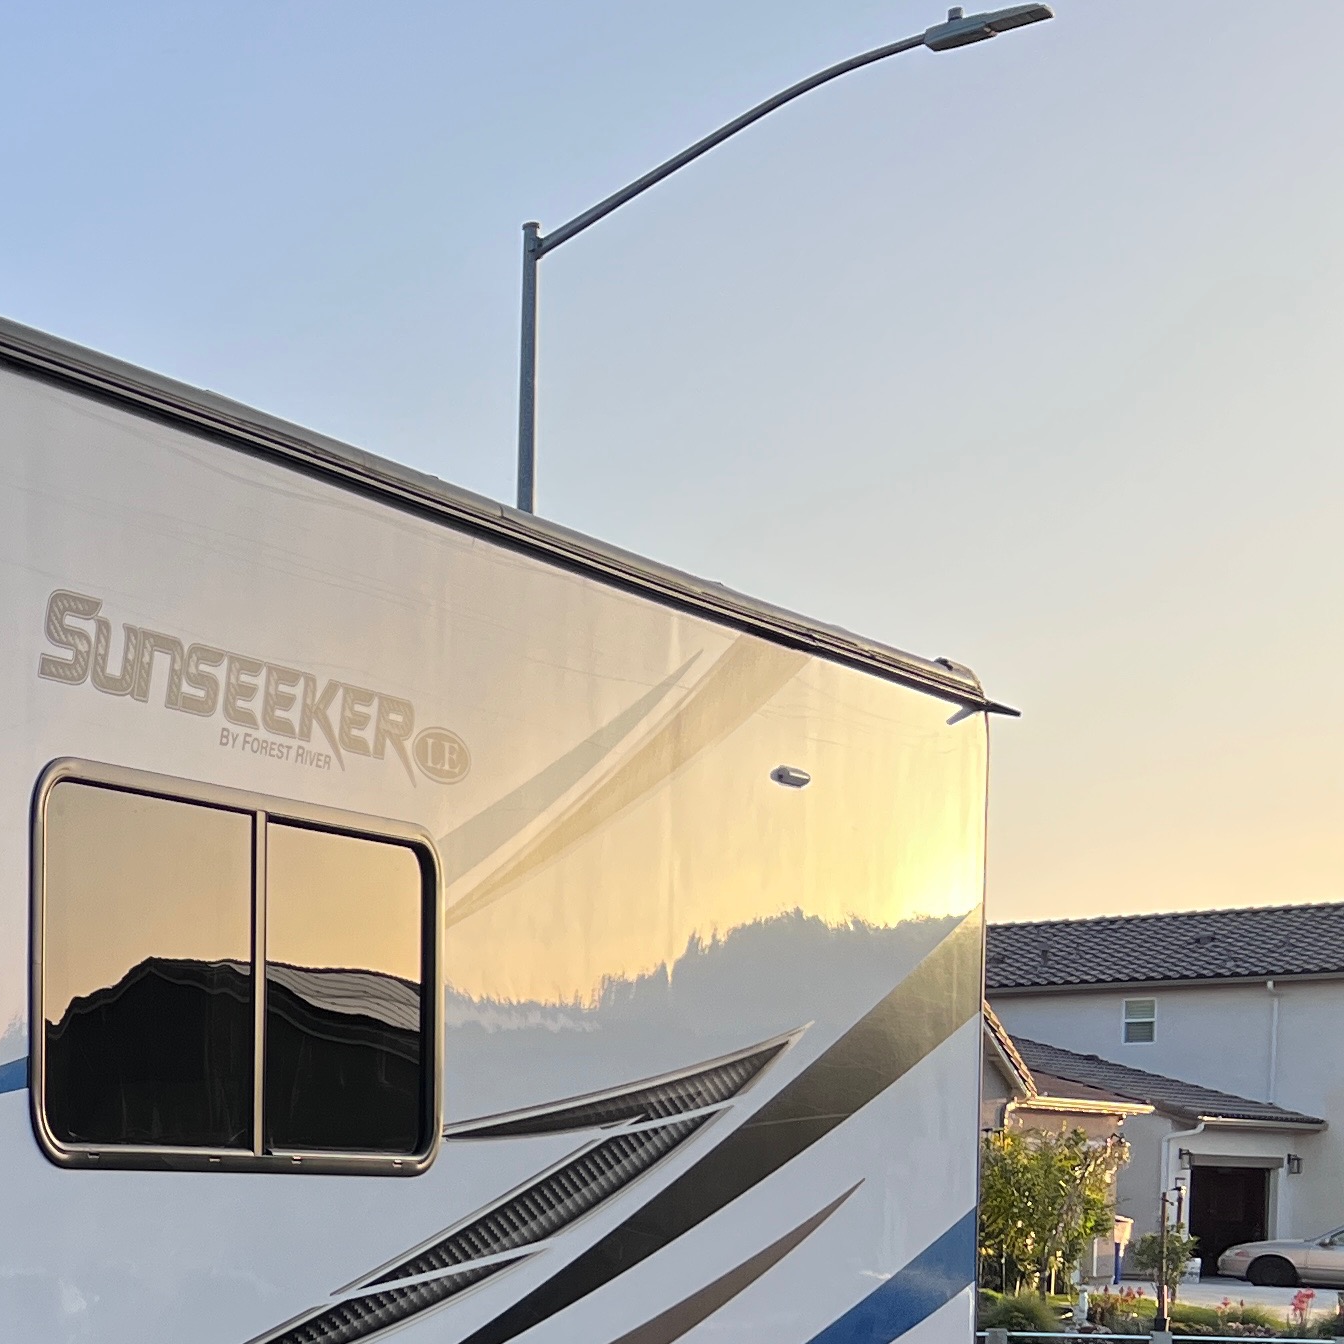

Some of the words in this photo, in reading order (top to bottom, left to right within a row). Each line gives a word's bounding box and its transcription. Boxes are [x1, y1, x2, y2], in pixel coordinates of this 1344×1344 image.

[219, 727, 239, 749] BY
[242, 733, 292, 762] FOREST
[295, 744, 332, 771] RIVER
[425, 736, 462, 774] LE
